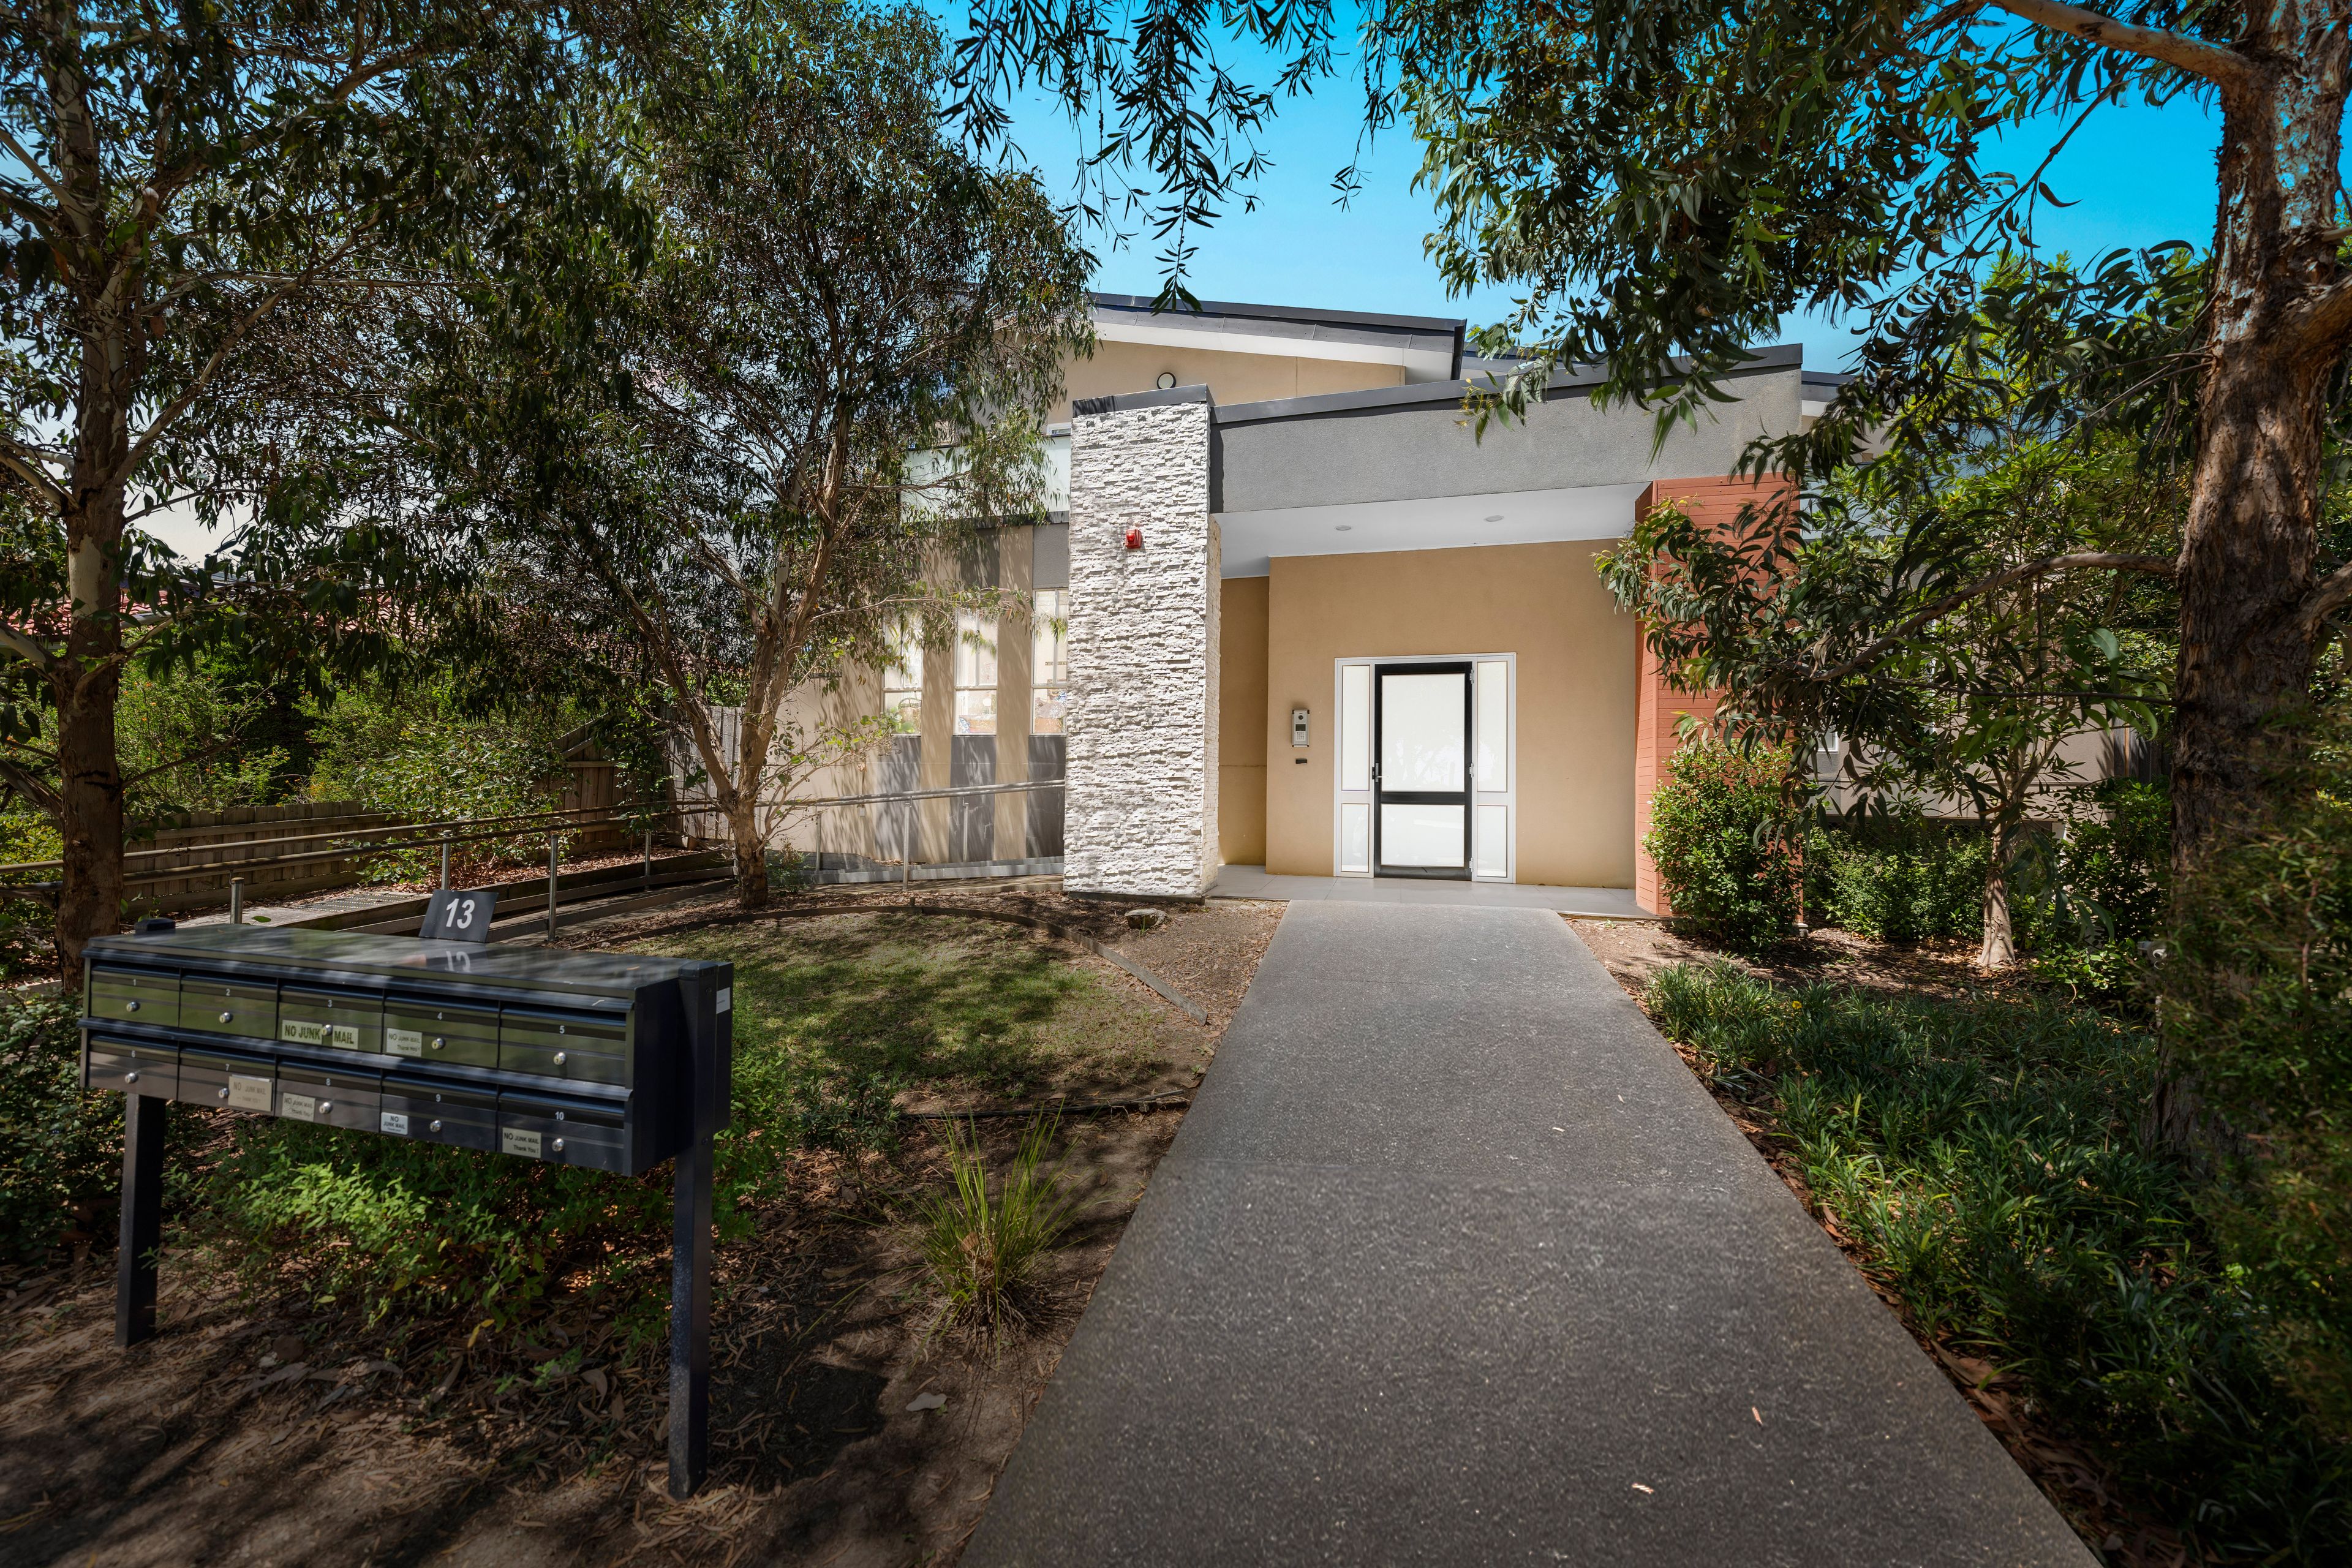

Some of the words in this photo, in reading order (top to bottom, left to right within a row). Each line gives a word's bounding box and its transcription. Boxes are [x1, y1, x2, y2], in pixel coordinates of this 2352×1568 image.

[446, 898, 475, 929] 13
[328, 999, 333, 1008] 3
[559, 1025, 565, 1034] 5
[284, 1025, 296, 1036] NO
[298, 1027, 321, 1040] JUNK
[334, 1031, 354, 1044] MAIL
[234, 1082, 241, 1091] NO
[435, 1094, 441, 1102] 9
[555, 1112, 564, 1120] 10
[504, 1132, 513, 1140] NO
